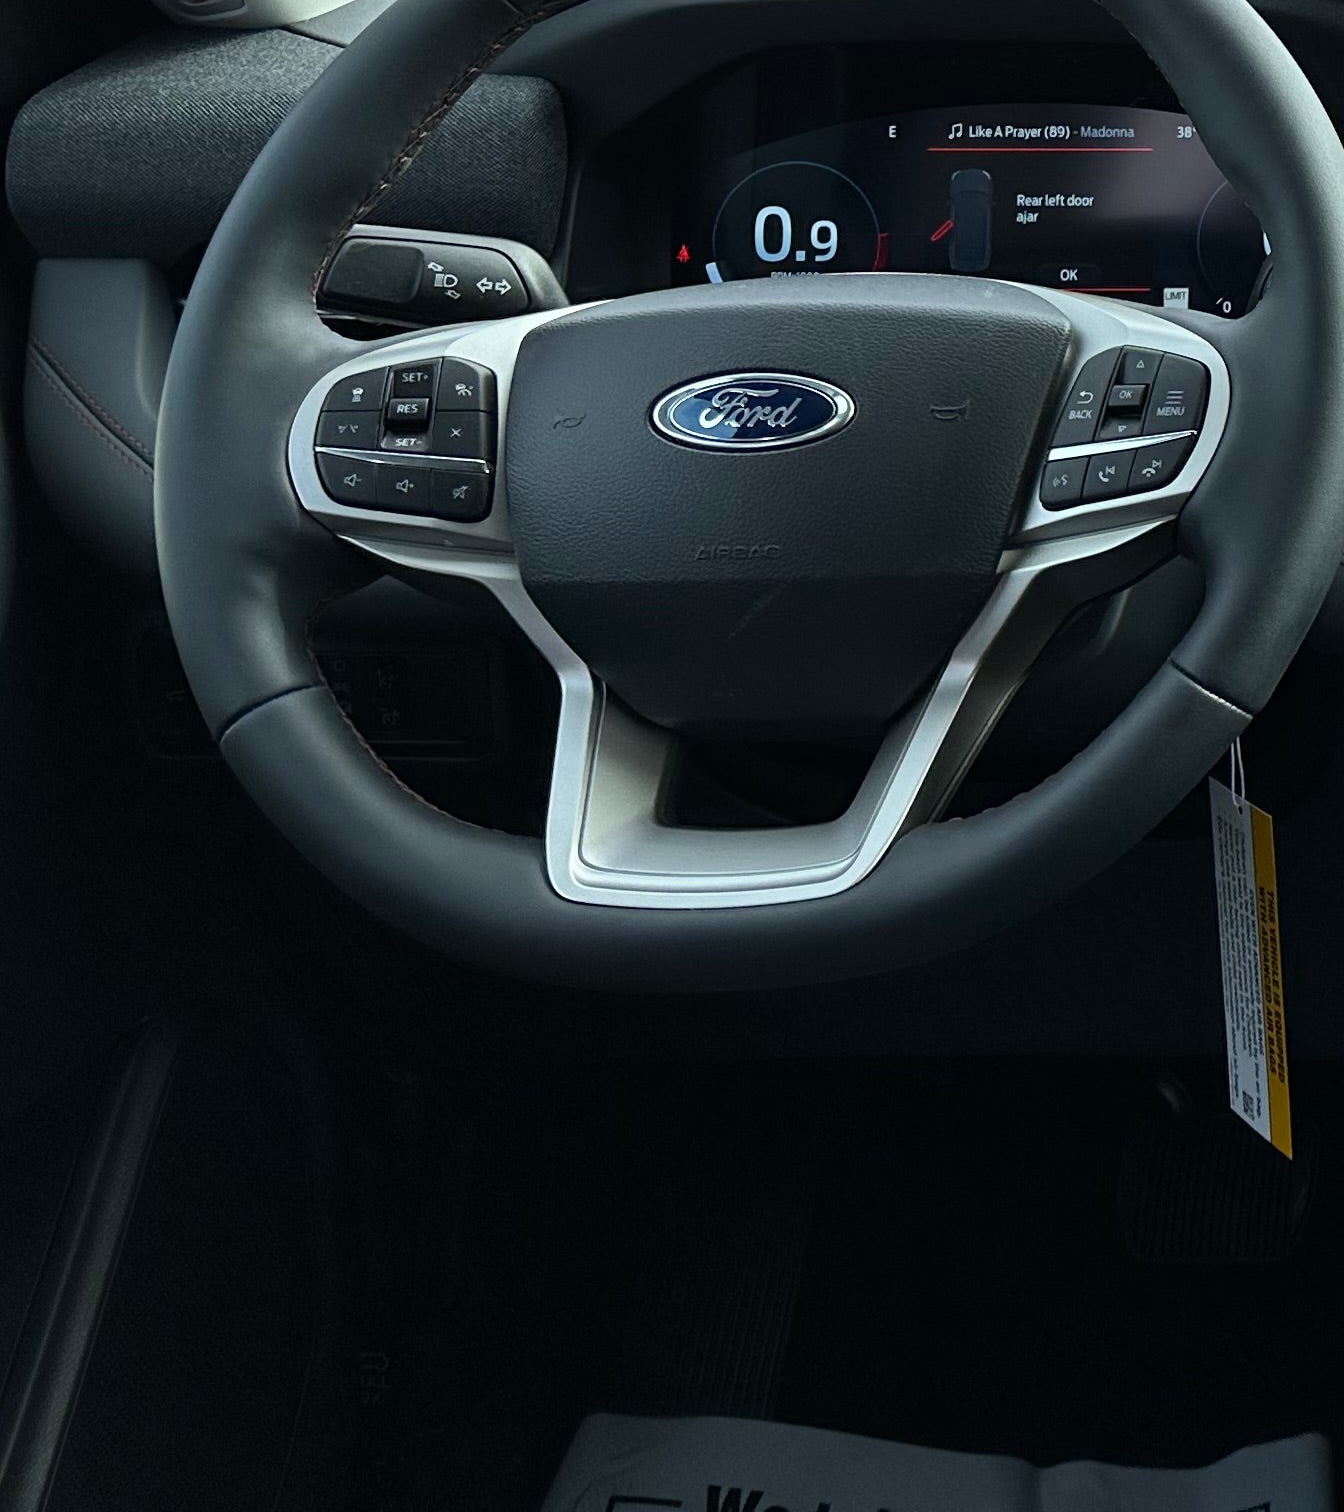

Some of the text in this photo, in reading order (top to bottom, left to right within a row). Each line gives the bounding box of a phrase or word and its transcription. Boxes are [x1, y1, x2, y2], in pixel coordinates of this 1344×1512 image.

[888, 126, 897, 138] E
[968, 125, 993, 139] Like
[994, 126, 1003, 138] A
[1005, 125, 1041, 141] Prayer
[1044, 125, 1071, 140] (89)
[1080, 125, 1135, 139] Madonna
[1016, 193, 1094, 207] Rear left door
[1016, 210, 1039, 225] ajar
[754, 204, 839, 263] 0.9
[1060, 269, 1078, 281] OK
[1164, 291, 1188, 301] LIMIT
[402, 372, 429, 383] SET+
[1119, 390, 1133, 400] OK
[397, 403, 419, 414] RES
[700, 388, 802, 429] Ford
[1069, 409, 1093, 420] BACK
[1156, 406, 1185, 418] MENU
[395, 438, 422, 447] SET-
[1259, 886, 1267, 923] WITH
[1261, 925, 1272, 1004] ADVANCED
[1267, 891, 1285, 1083] THIS VEHICLE IS EQUIPPED
[1268, 1036, 1277, 1076] BAGS
